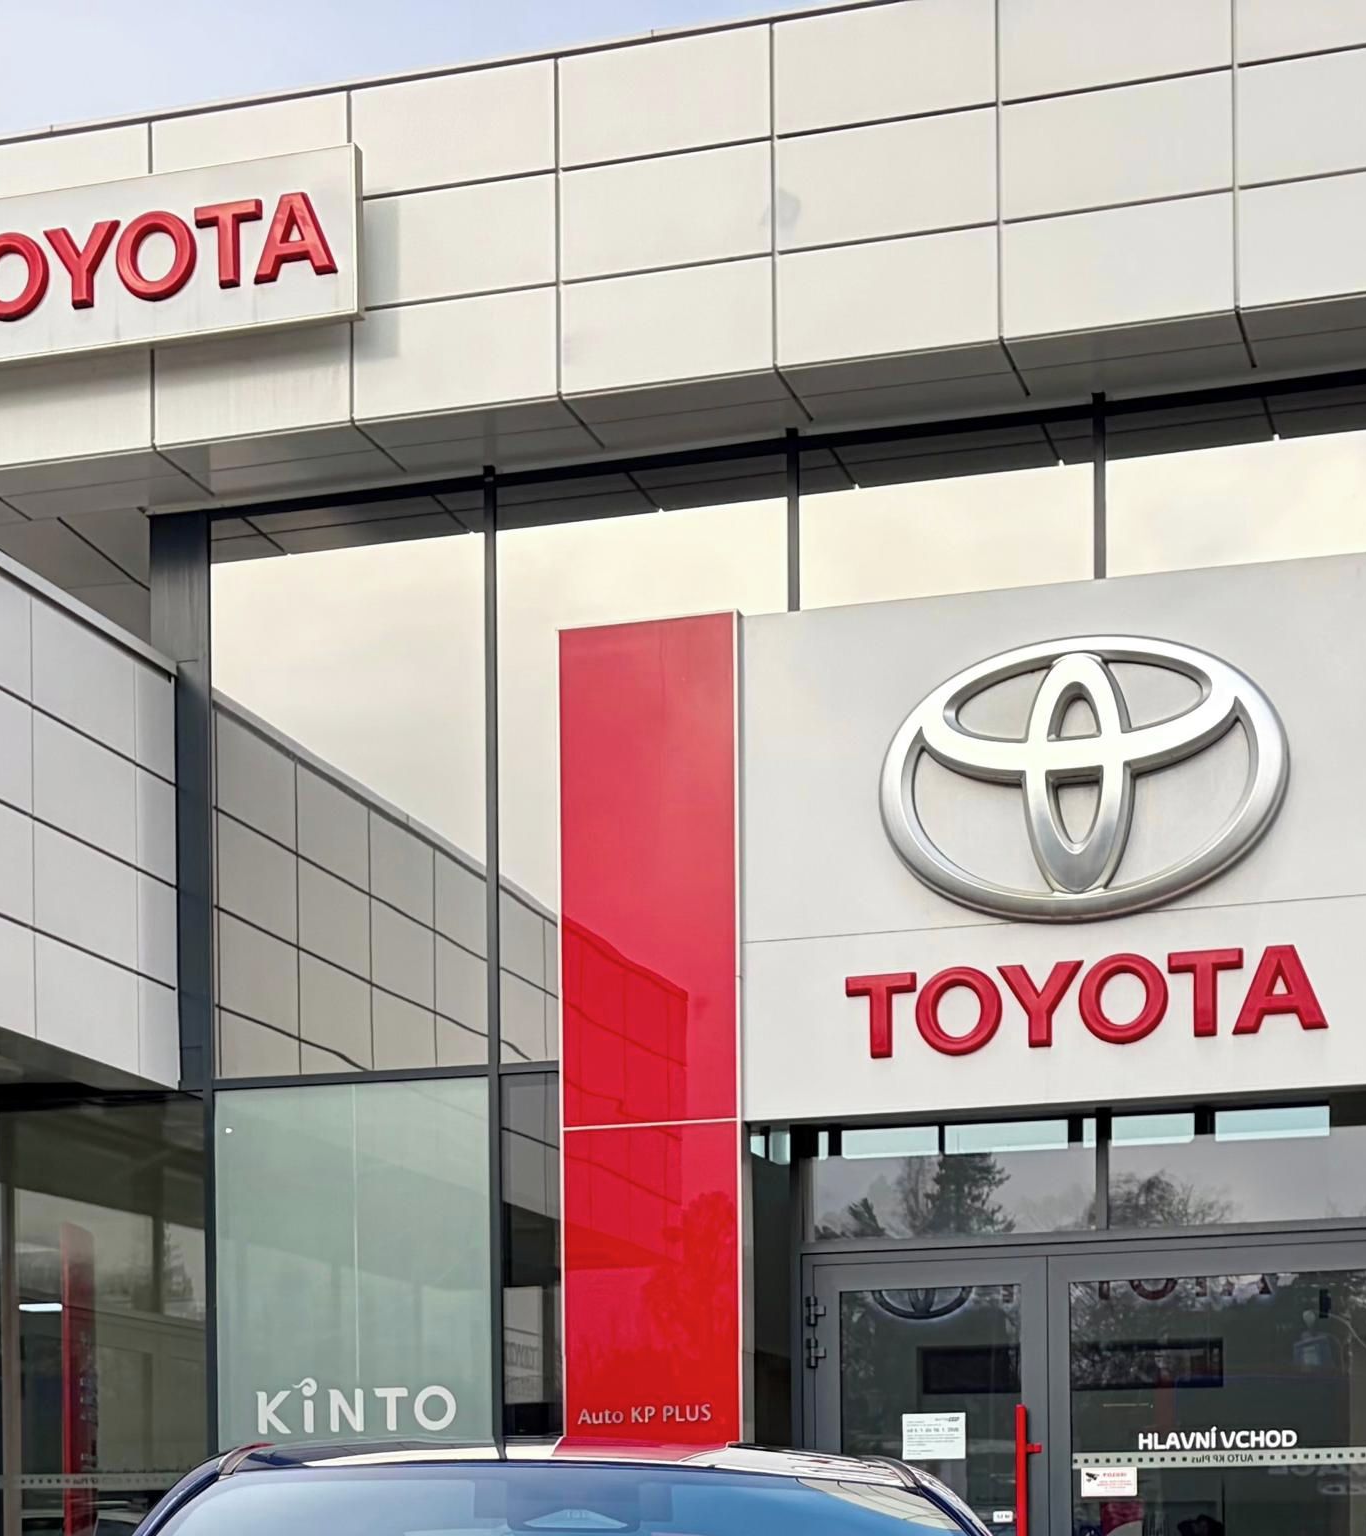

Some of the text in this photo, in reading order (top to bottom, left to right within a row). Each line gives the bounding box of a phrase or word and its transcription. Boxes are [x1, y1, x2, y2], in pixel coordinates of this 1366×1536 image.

[845, 944, 1328, 1058] TOYOTA
[578, 1404, 712, 1425] Auto KP PLUS
[1138, 1426, 1298, 1450] HLAVNÍ VCHOD
